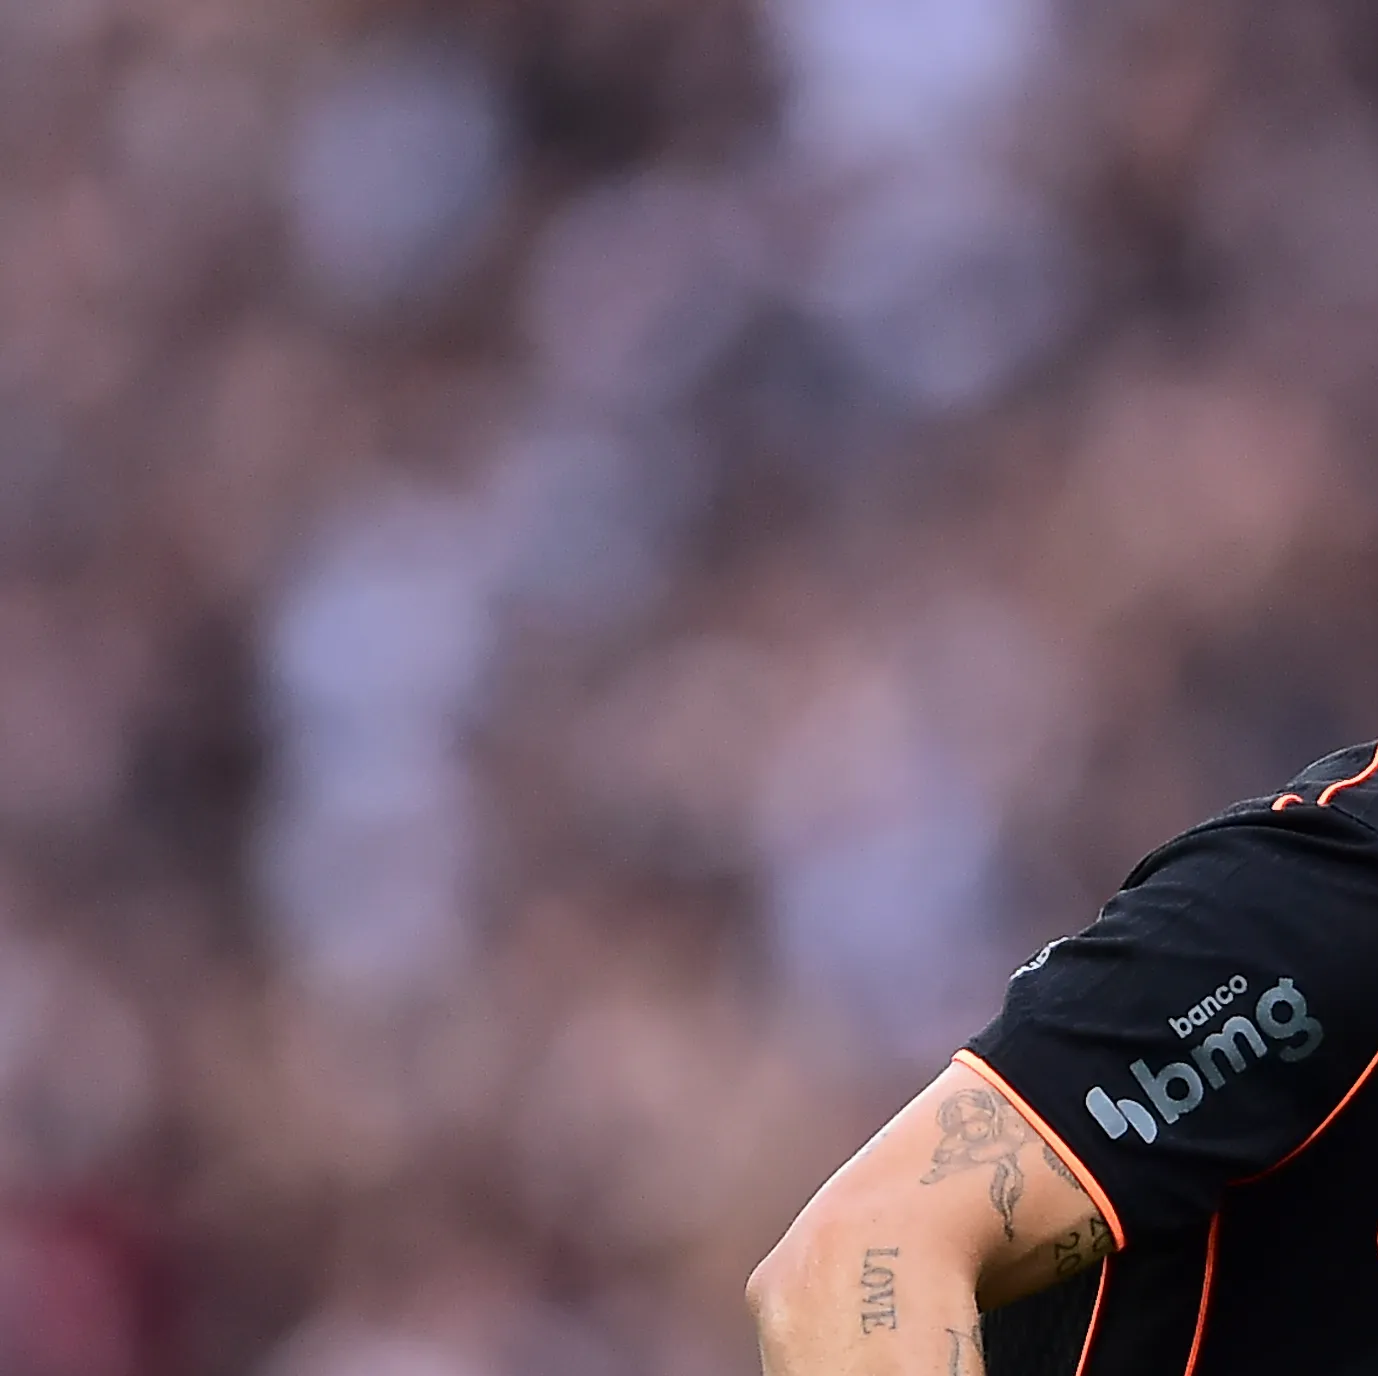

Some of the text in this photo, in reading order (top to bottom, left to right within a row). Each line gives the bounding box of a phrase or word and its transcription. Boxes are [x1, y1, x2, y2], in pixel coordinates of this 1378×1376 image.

[1129, 976, 1325, 1126] bmg
[1168, 974, 1249, 1040] banco
[861, 1246, 900, 1335] LOVE
